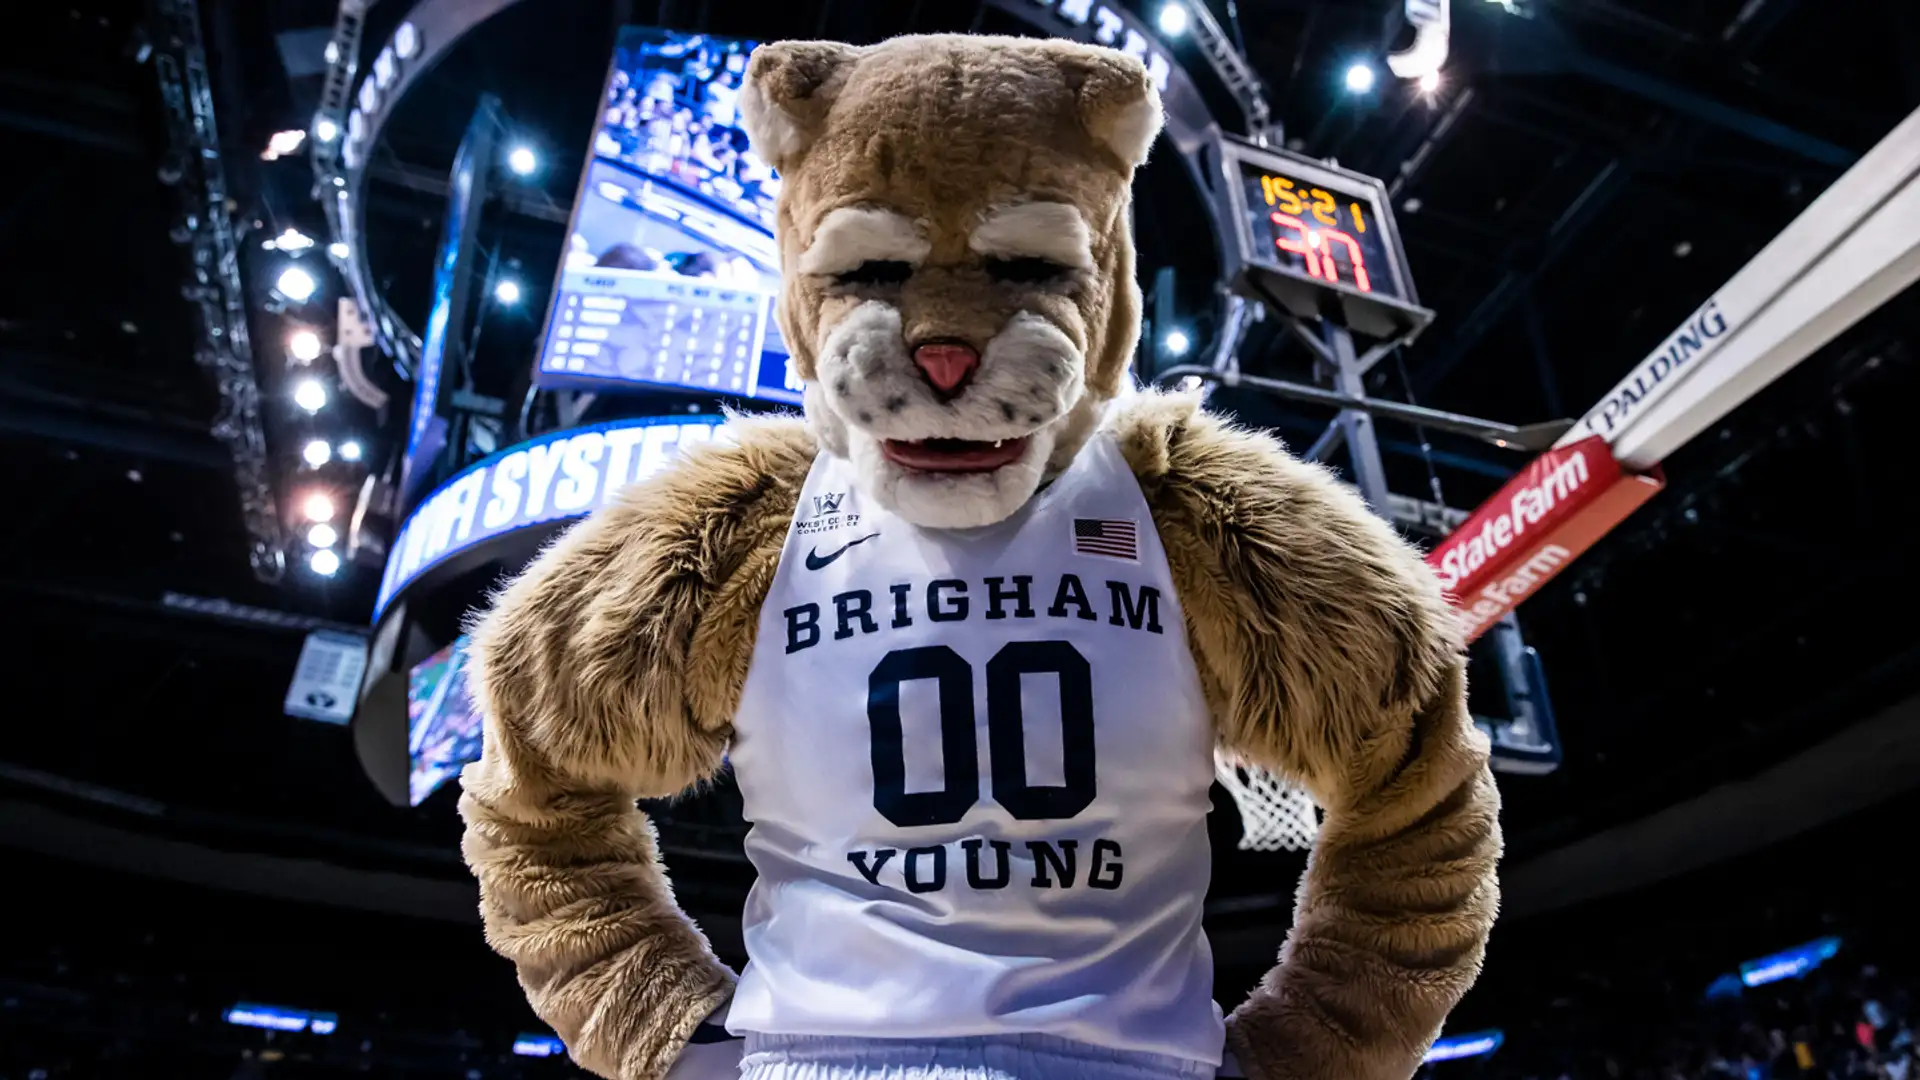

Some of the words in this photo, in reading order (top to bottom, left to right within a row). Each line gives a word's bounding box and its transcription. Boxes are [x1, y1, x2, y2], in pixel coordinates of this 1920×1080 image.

[1260, 174, 1367, 234] 15:21
[1585, 300, 1728, 432] PALDING
[482, 423, 735, 529] SYSTE
[796, 520, 825, 530] WEST
[827, 514, 860, 526] COST
[797, 521, 858, 535] CONFERECE
[783, 574, 1165, 655] BRIGHAM
[867, 640, 1097, 828] 00
[847, 838, 1124, 894] YOUNG
